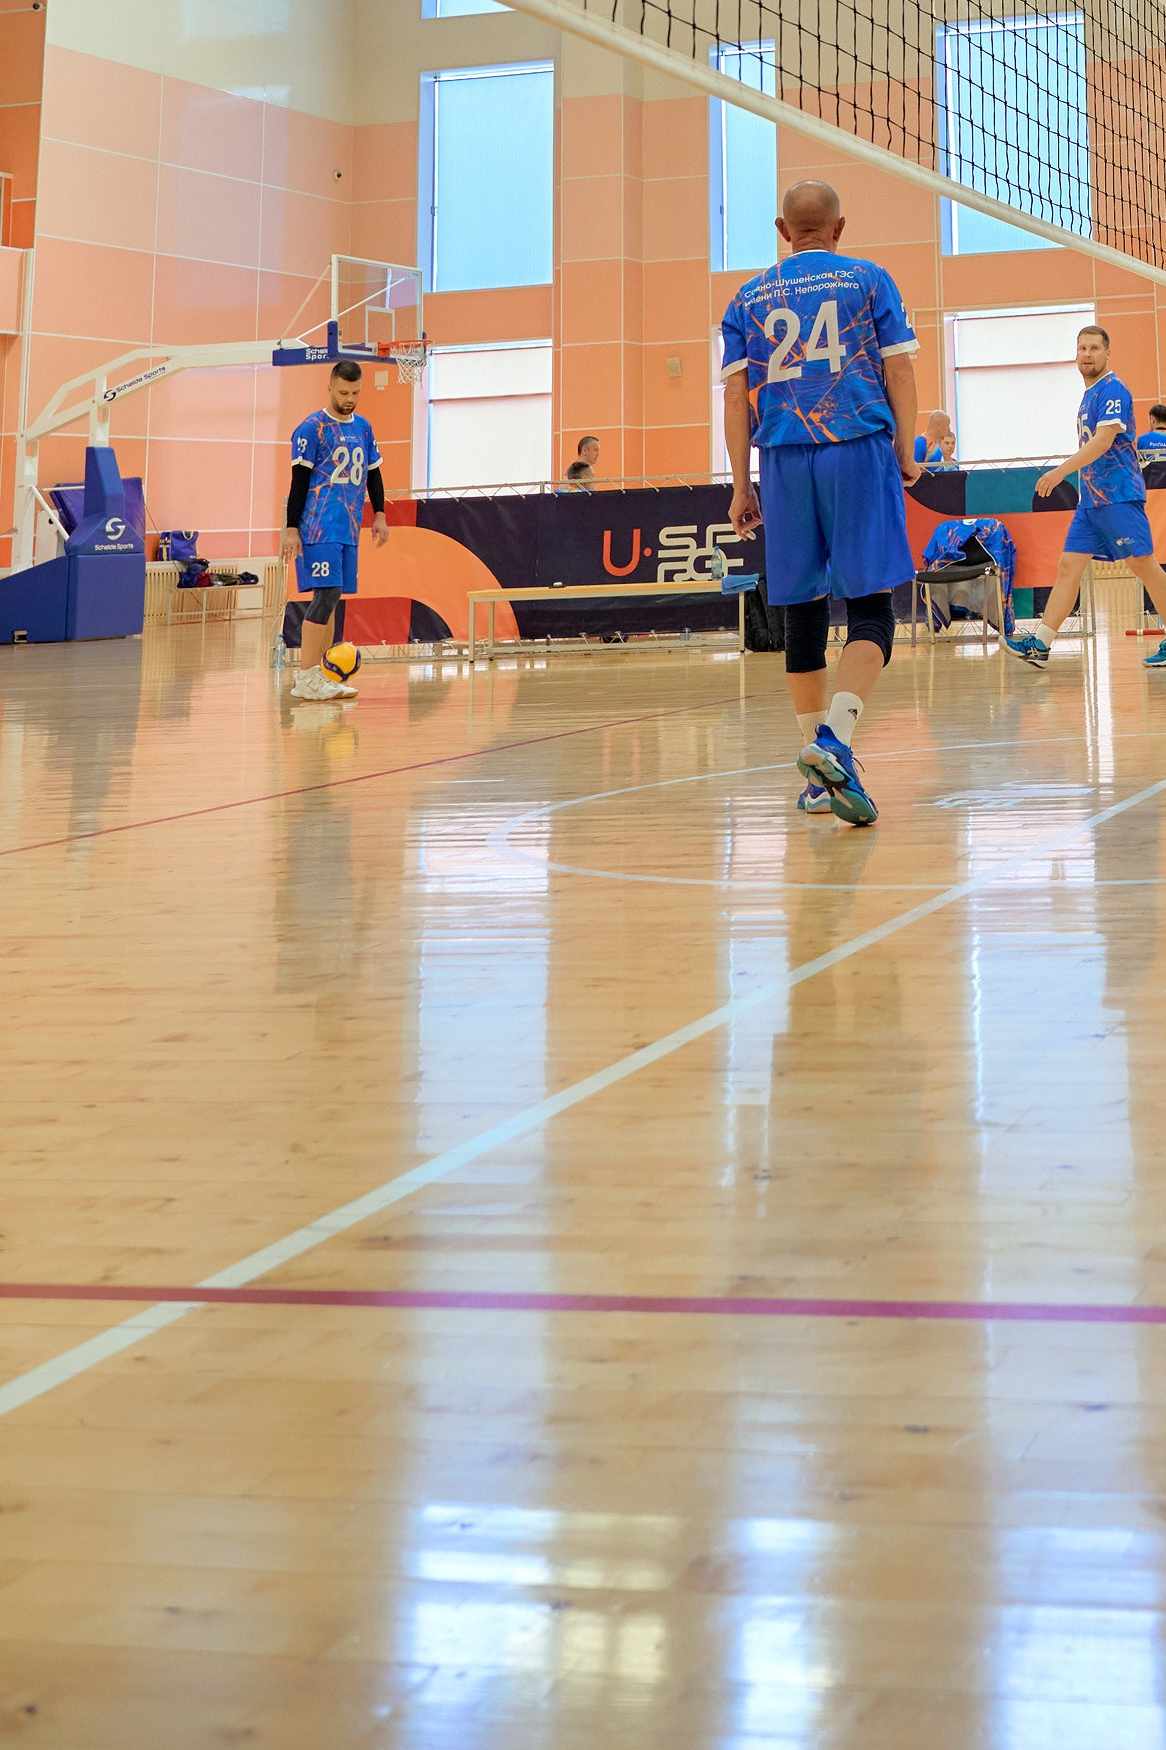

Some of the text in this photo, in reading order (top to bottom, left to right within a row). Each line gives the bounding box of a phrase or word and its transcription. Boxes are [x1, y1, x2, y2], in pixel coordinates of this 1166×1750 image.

[835, 270, 855, 279] ГЭС
[774, 288, 794, 298] П.С.
[795, 281, 860, 295] Непорожнего
[764, 300, 847, 384] 24
[143, 366, 166, 379] Sports
[1105, 399, 1122, 415] 25
[330, 446, 364, 485] 28
[311, 561, 330, 577] 28
